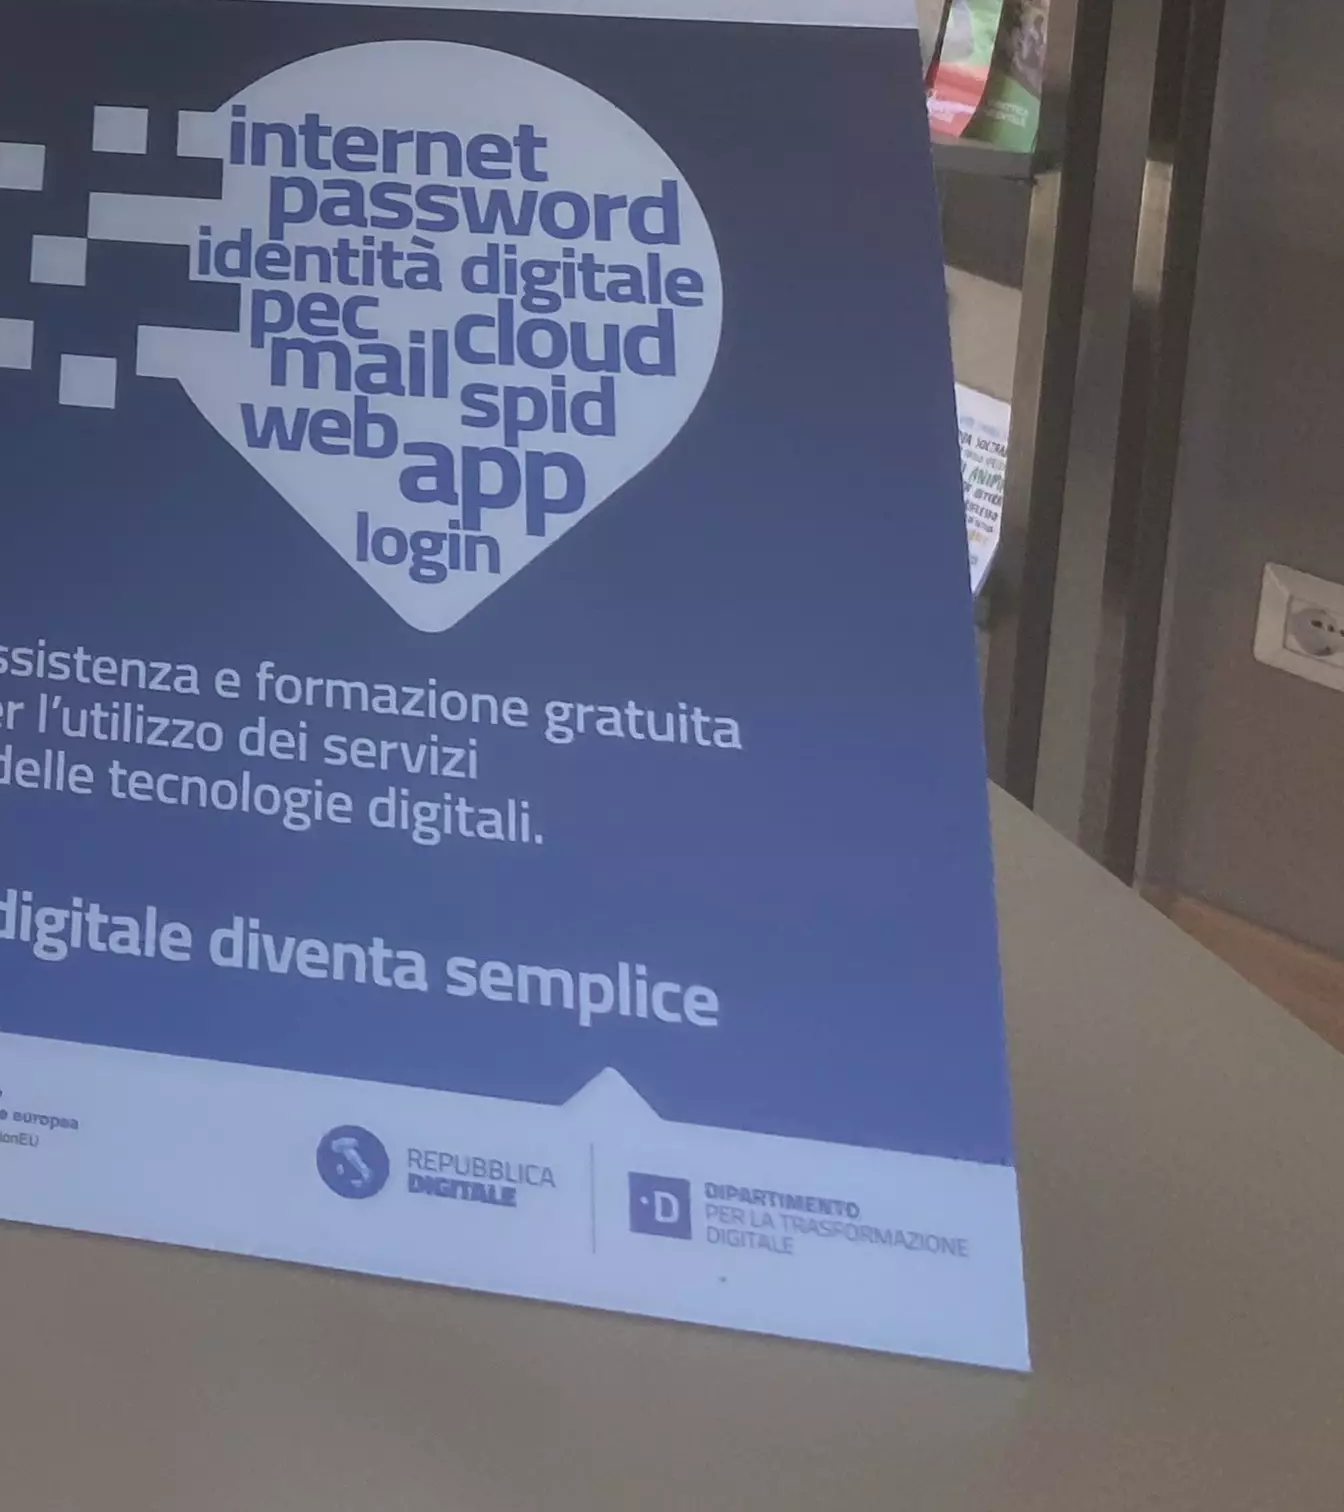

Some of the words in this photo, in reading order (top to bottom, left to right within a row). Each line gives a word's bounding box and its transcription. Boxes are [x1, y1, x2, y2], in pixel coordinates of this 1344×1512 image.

[230, 104, 548, 181] internet
[268, 174, 681, 245] password
[197, 225, 442, 292] identità
[461, 243, 705, 314] digitale
[250, 289, 379, 348] pec
[454, 298, 676, 376] cloud
[271, 329, 449, 398] mail
[240, 395, 398, 459] web
[461, 374, 616, 446] spid
[398, 441, 585, 537] app
[356, 511, 501, 584] login
[38, 692, 223, 754] l'utilizzo
[238, 716, 308, 763] dei
[322, 725, 478, 781] servizi
[214, 664, 241, 698] e
[256, 661, 529, 729] formazione
[543, 695, 743, 751] gratuita
[109, 754, 353, 833] tecnologie
[369, 784, 545, 847] digitali.
[208, 916, 429, 993] diventa
[445, 948, 720, 1029] semplice
[13, 1111, 79, 1131] europea
[407, 1149, 556, 1189] REPUBBLICA
[407, 1172, 517, 1208] DIGITALE
[705, 1182, 860, 1218] DIPARTIMENTO
[704, 1203, 743, 1226] PER
[749, 1209, 776, 1230] LA
[780, 1214, 969, 1258] TRASFORMAZIONE
[705, 1225, 794, 1256] DIGITALE
